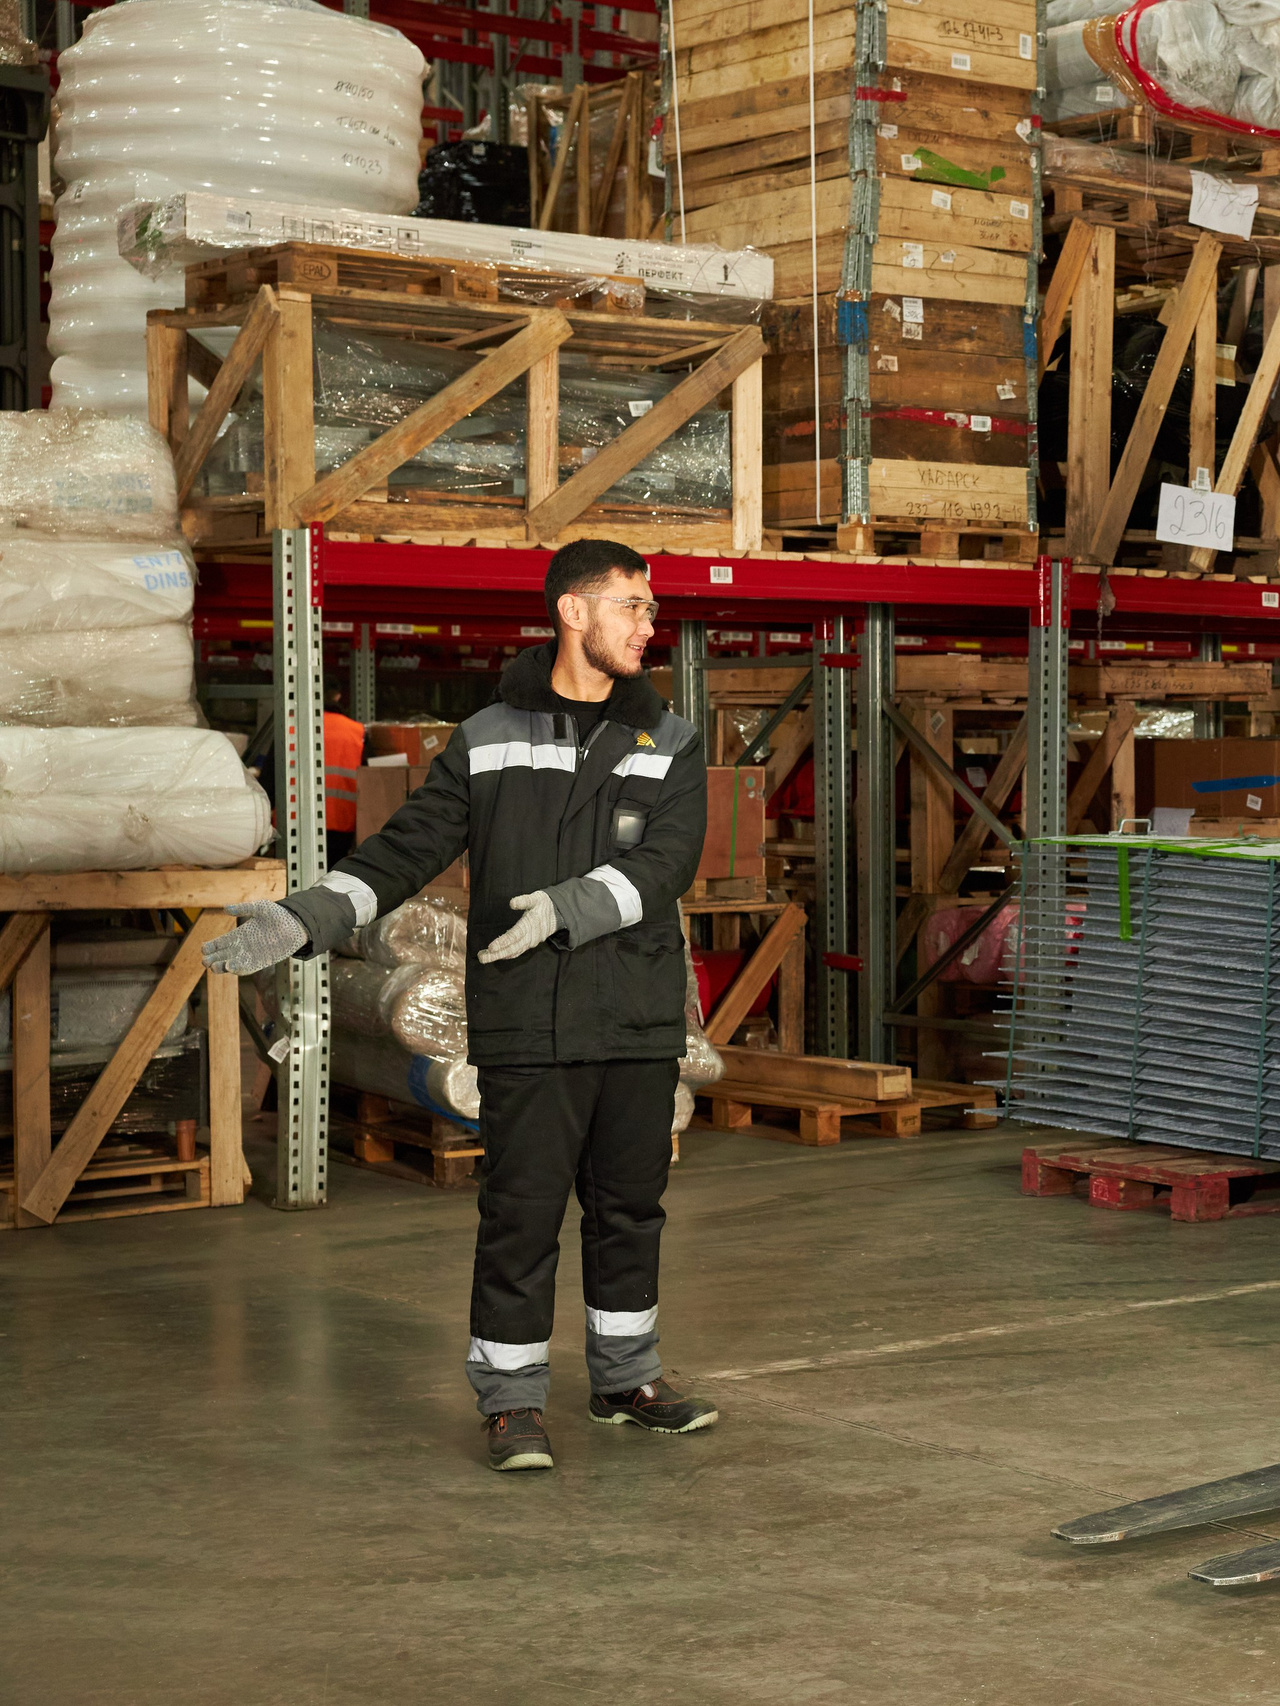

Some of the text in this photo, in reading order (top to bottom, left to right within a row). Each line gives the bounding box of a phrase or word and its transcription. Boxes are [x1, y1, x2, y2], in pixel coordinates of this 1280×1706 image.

[638, 268, 684, 281] ПЕРФЕКТ
[906, 501, 930, 516] 232
[1169, 494, 1226, 540] 2316
